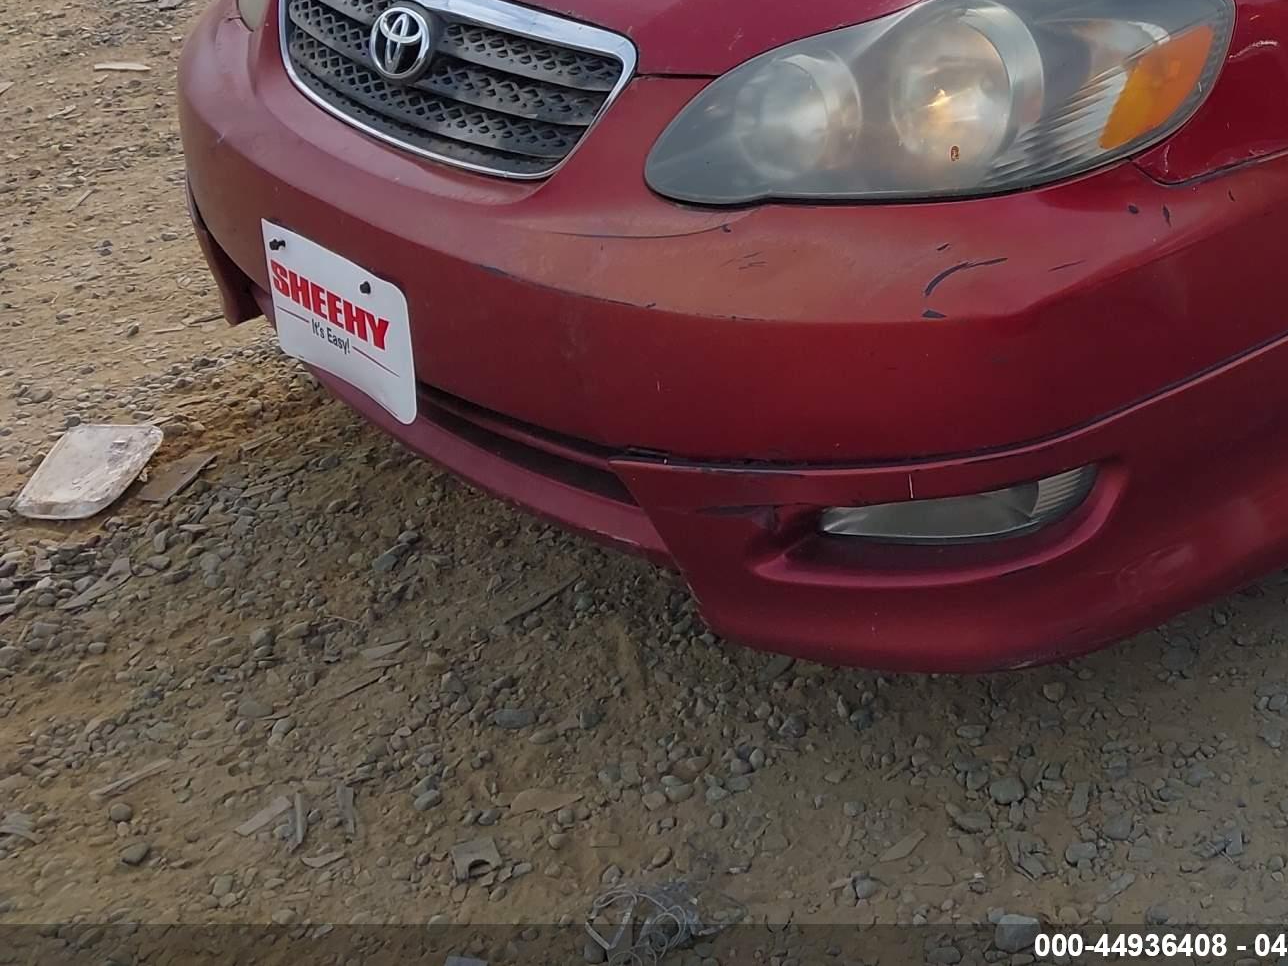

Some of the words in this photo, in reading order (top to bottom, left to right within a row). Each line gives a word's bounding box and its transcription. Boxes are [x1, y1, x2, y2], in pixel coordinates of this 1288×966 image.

[271, 259, 390, 350] SHEEHY
[311, 318, 325, 339] It's
[327, 328, 350, 354] Easy!
